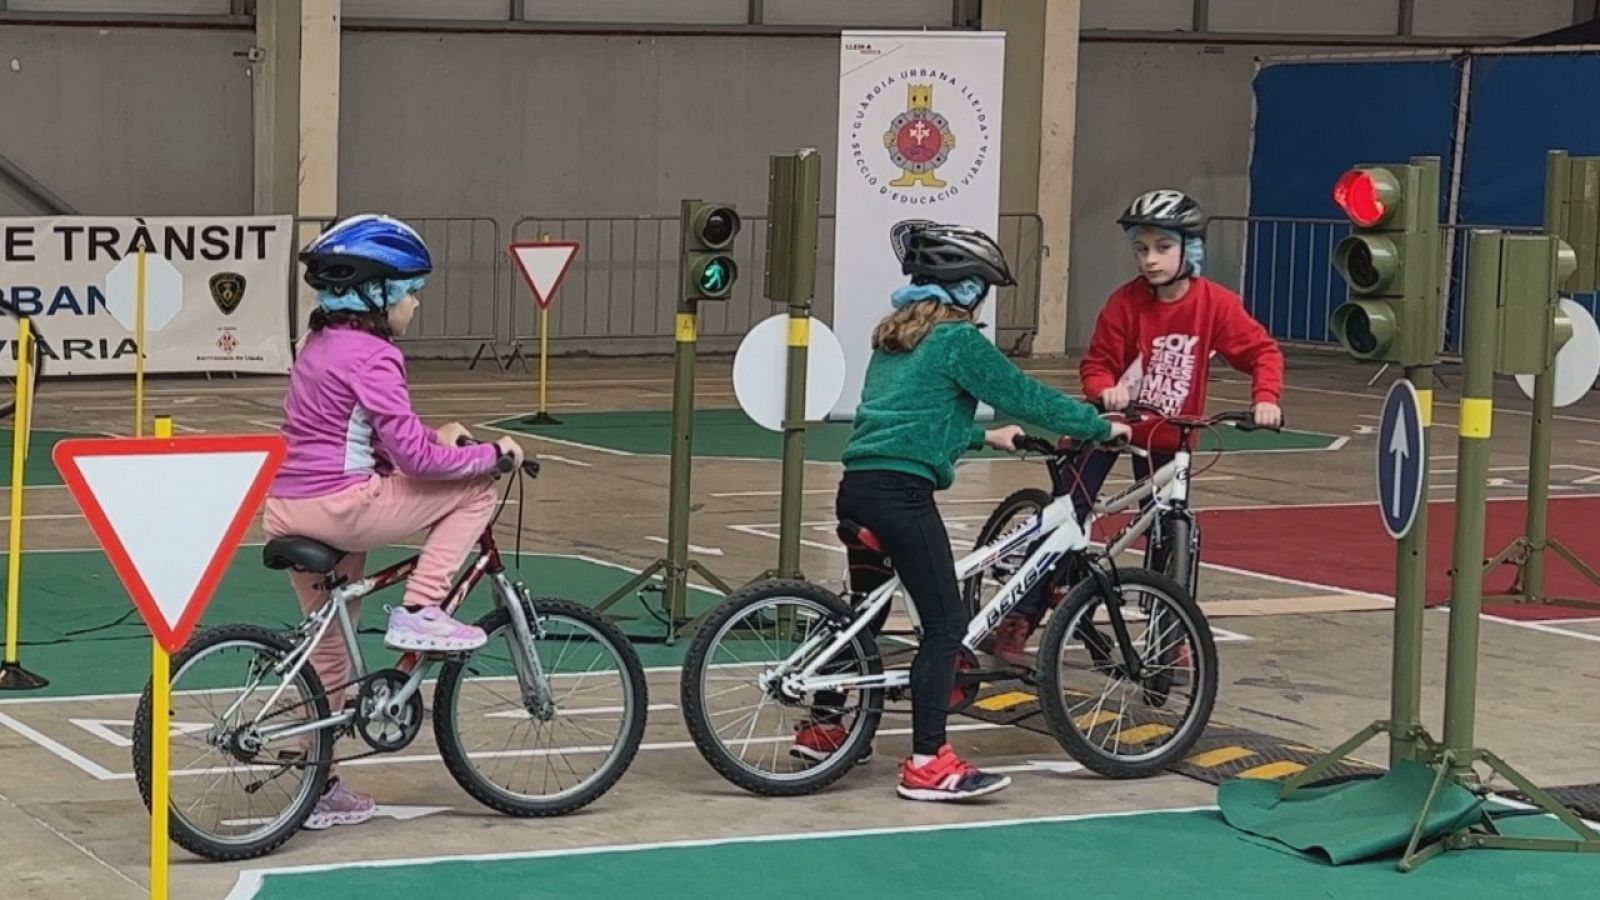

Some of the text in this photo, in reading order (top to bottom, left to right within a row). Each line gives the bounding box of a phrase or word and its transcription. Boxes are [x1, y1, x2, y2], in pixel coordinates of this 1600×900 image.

[900, 69, 957, 86] URBANA
[961, 86, 987, 132] LLEIDA
[54, 217, 276, 261] TRÀNSIT
[1152, 334, 1199, 355] SOY
